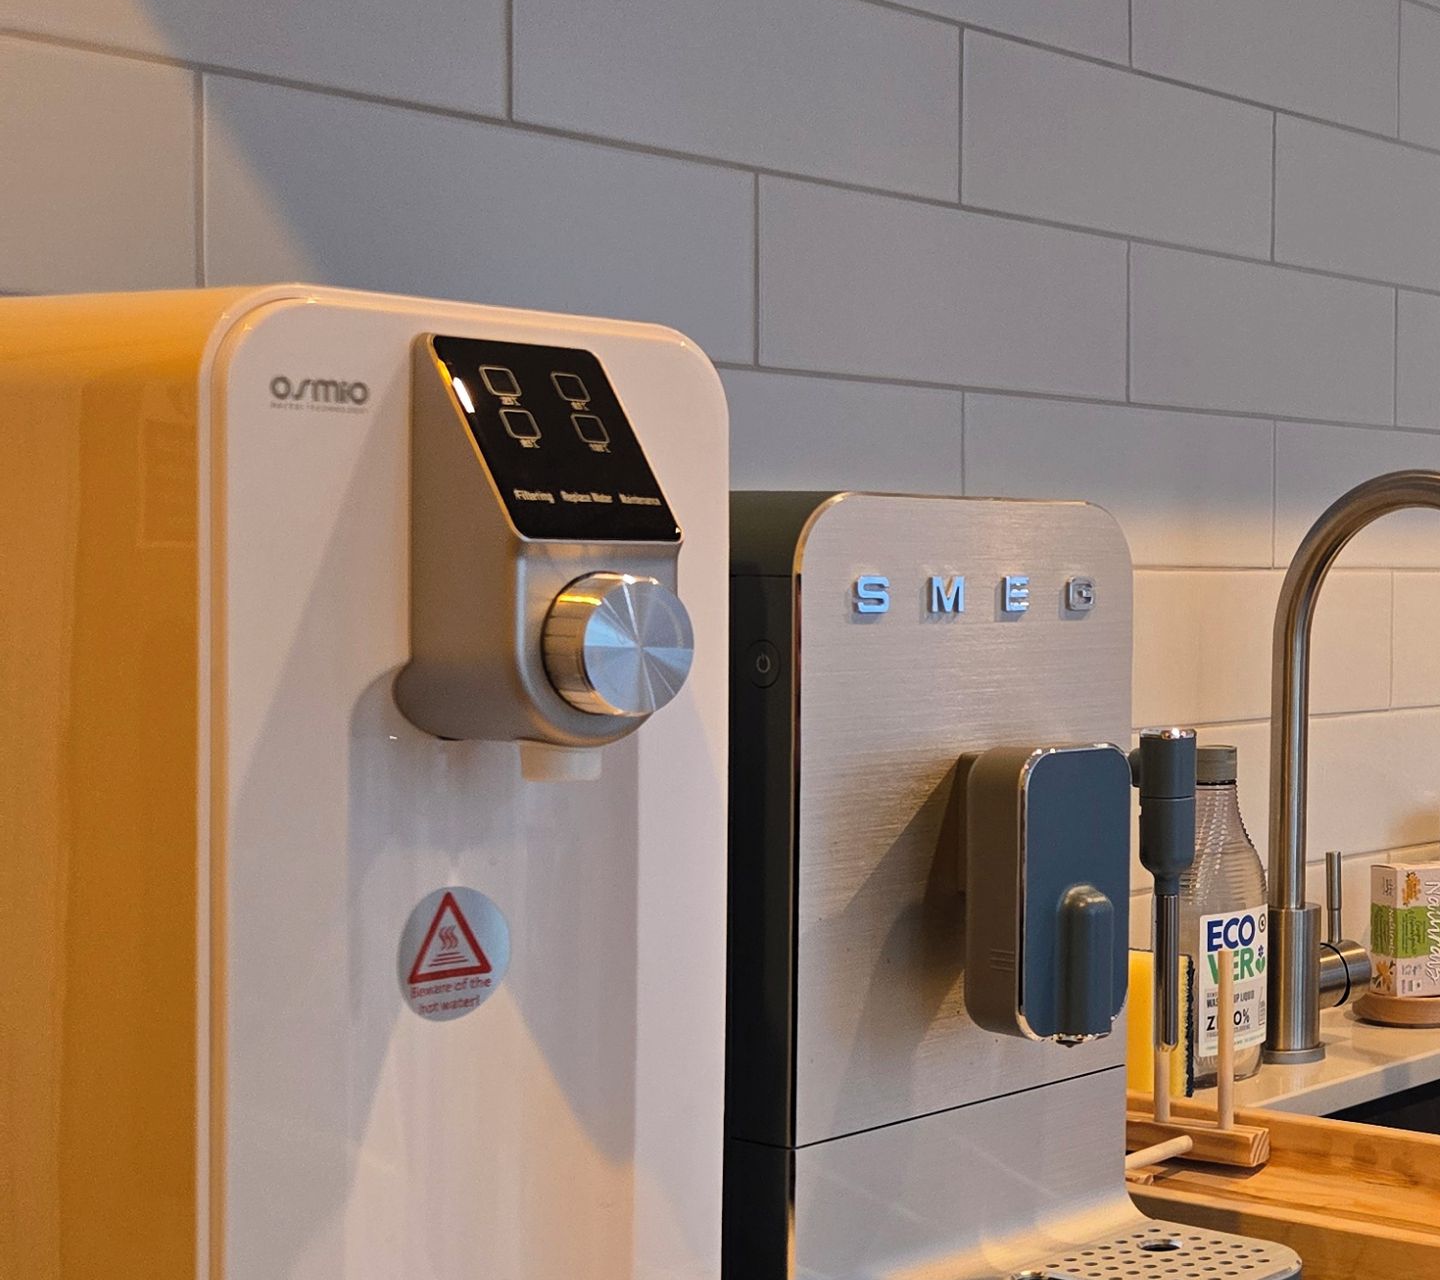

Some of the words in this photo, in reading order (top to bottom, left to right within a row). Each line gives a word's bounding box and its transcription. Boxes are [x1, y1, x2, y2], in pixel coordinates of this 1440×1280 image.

[513, 488, 556, 504] Filtering
[856, 575, 1097, 612] SMEG
[1207, 914, 1256, 952] ECO
[410, 983, 452, 999] Beware
[454, 977, 469, 989] of
[470, 976, 492, 989] the
[418, 1001, 440, 1014] hot
